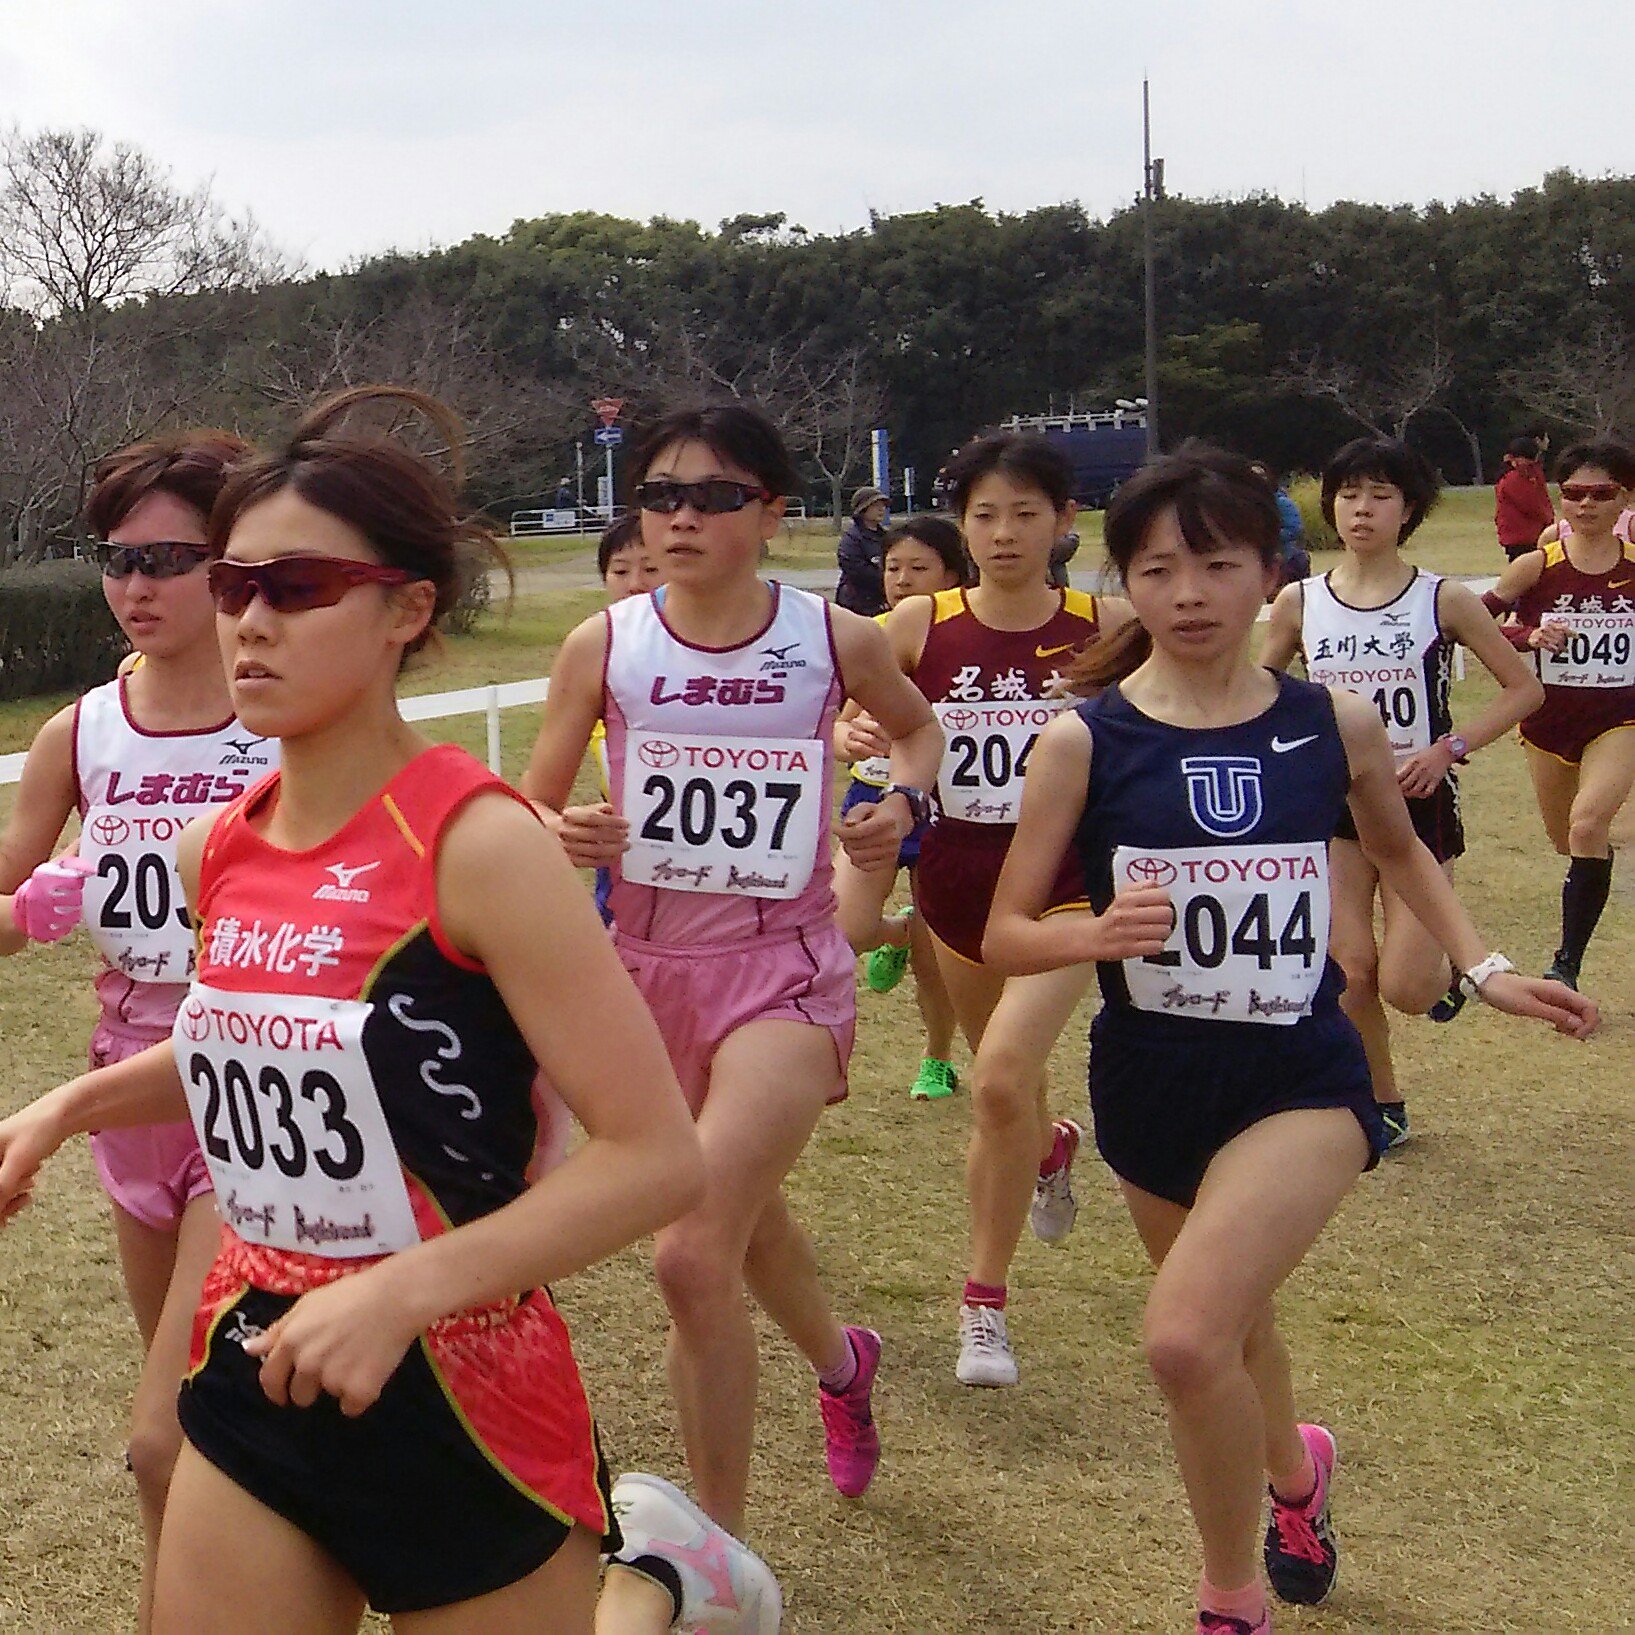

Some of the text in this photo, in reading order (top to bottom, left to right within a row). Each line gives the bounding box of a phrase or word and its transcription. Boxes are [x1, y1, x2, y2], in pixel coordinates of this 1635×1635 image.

[1572, 618, 1634, 629] TOYOTA
[650, 672, 788, 705] しまむら
[1338, 667, 1417, 684] TOYOTA
[981, 708, 1059, 728] TOYO
[684, 746, 809, 772] TOYOTA
[949, 733, 1041, 788] 204
[105, 769, 249, 806] しまむら
[132, 816, 195, 841] TOY
[640, 774, 802, 850] 2037
[1181, 856, 1319, 883] TOYOTA
[208, 917, 345, 977] 積水化学
[210, 1009, 345, 1052] TOYOTA
[189, 1051, 365, 1182] 2033
